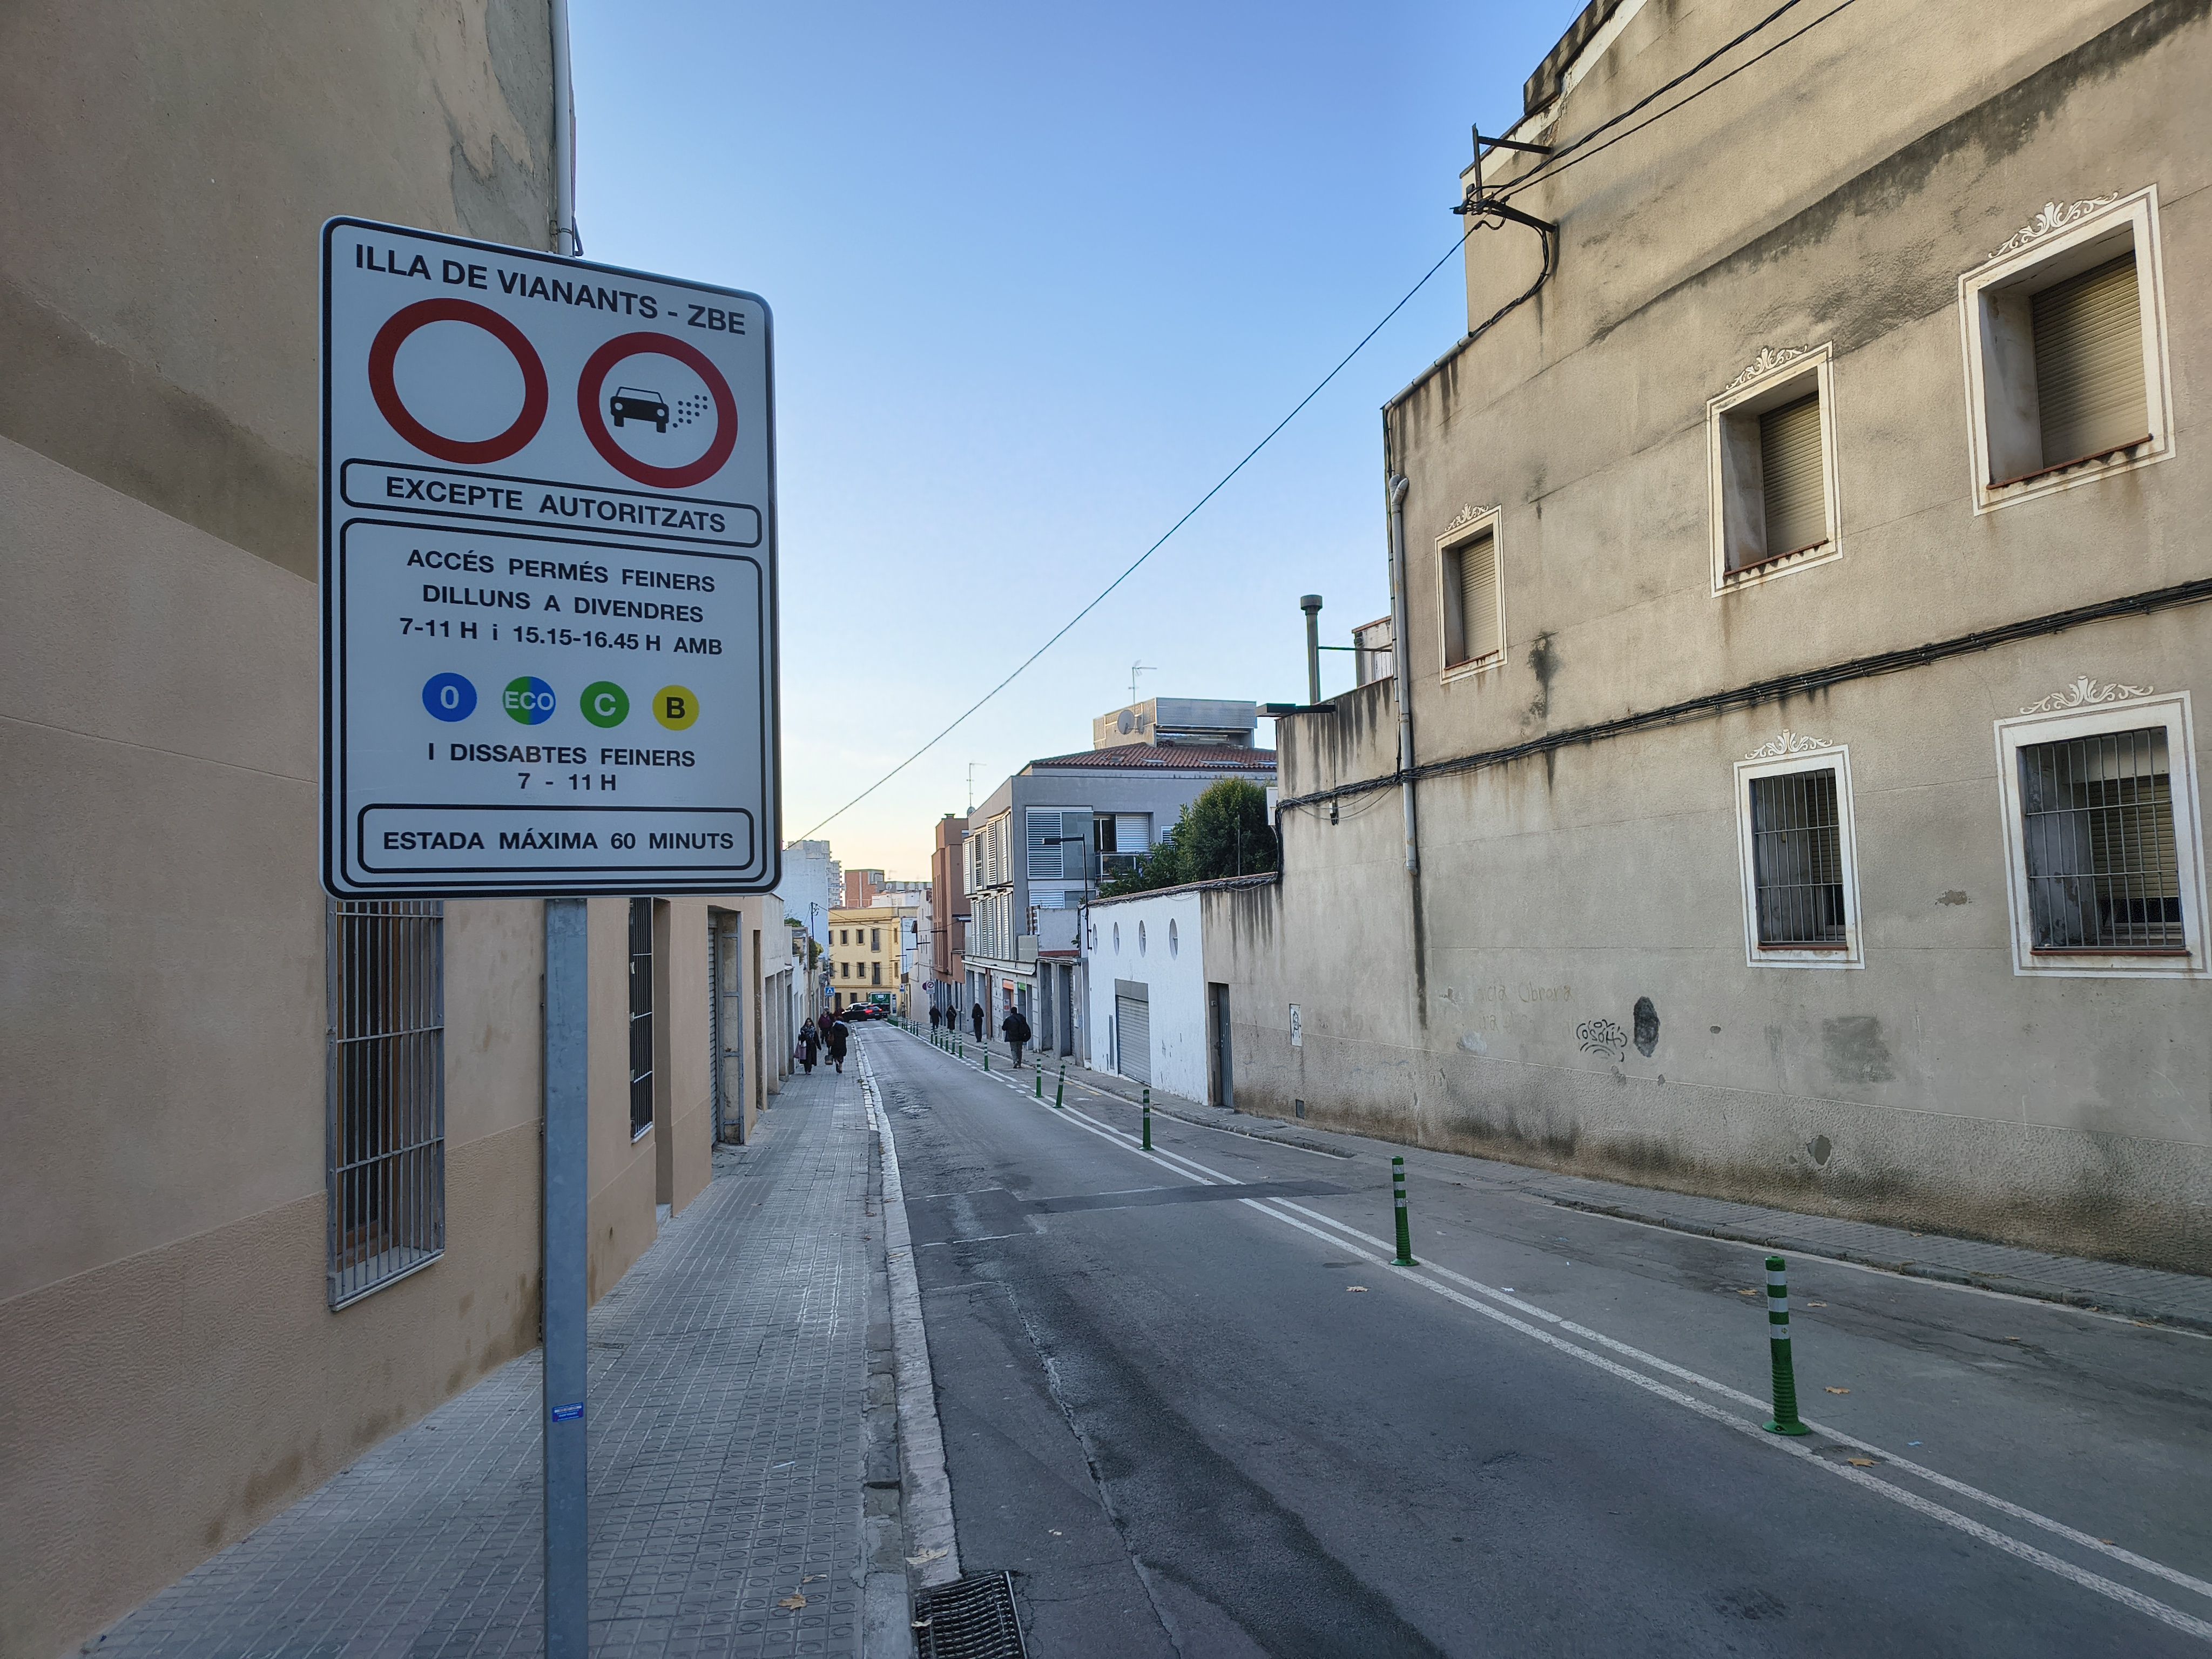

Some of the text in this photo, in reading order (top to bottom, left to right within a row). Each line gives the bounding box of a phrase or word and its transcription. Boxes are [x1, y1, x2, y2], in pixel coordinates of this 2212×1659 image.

[357, 244, 431, 280] ILLA
[443, 260, 487, 289] DE
[497, 268, 658, 320] VIANANTS
[688, 304, 745, 335] ZBE
[386, 476, 726, 532] EXCEPTE AUTORITZATS
[407, 550, 714, 592] ACCÉS PERMÉS FEINERS
[423, 585, 703, 622] DILLUNS A DIVENDRES
[400, 618, 722, 655] 7-11 H i 15.15-16.45 H AMB
[504, 691, 555, 711] ECO
[594, 693, 616, 717] C
[666, 697, 685, 718] B
[429, 743, 694, 767] I DISSABTES FEINERS
[518, 773, 530, 789] 7
[569, 774, 590, 790] 11
[601, 774, 616, 790] H
[384, 828, 733, 849] ESTADA MÁXIMA 60 MINUTS
